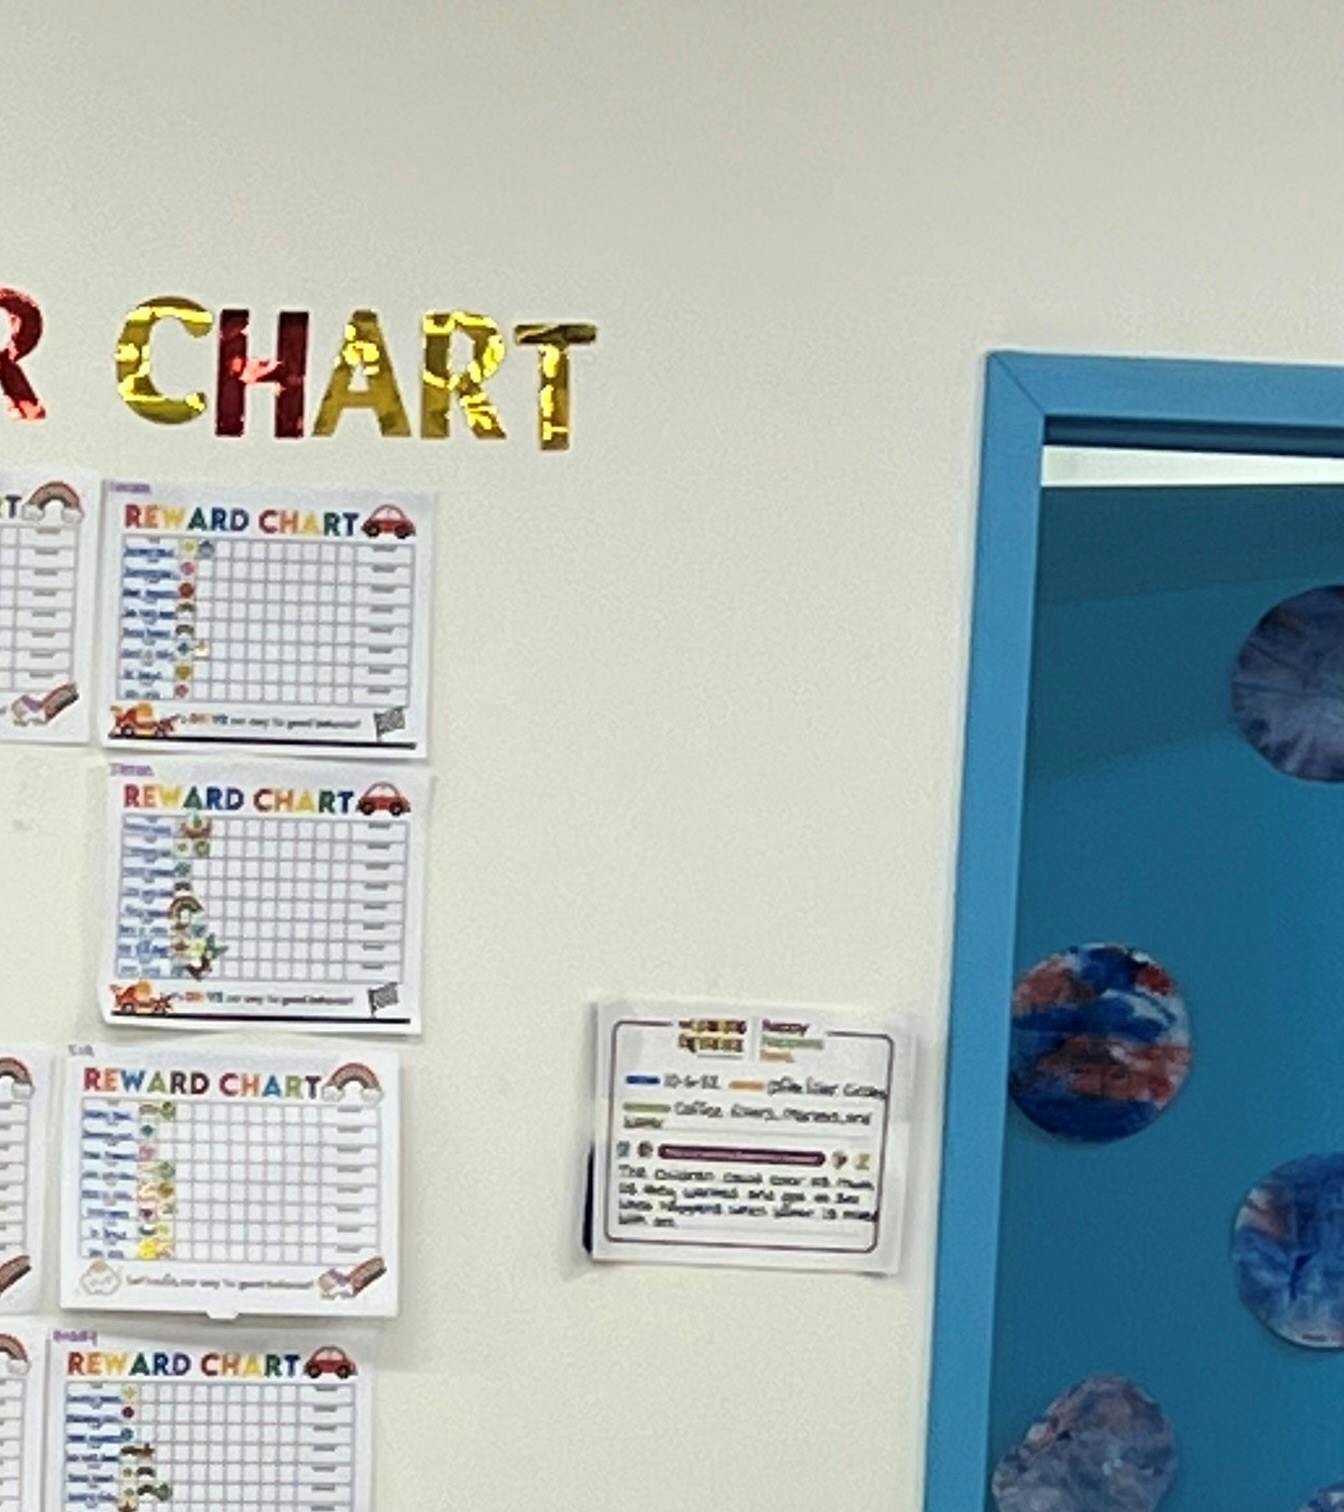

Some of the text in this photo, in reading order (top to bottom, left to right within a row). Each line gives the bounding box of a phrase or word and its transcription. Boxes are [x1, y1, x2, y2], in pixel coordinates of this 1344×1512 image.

[113, 295, 598, 452] CHART
[124, 504, 361, 536] REWARD CHART
[123, 784, 355, 814] REWARD CHART
[83, 1067, 322, 1100] REWARD CHART
[67, 1352, 301, 1379] REWARD CHART
